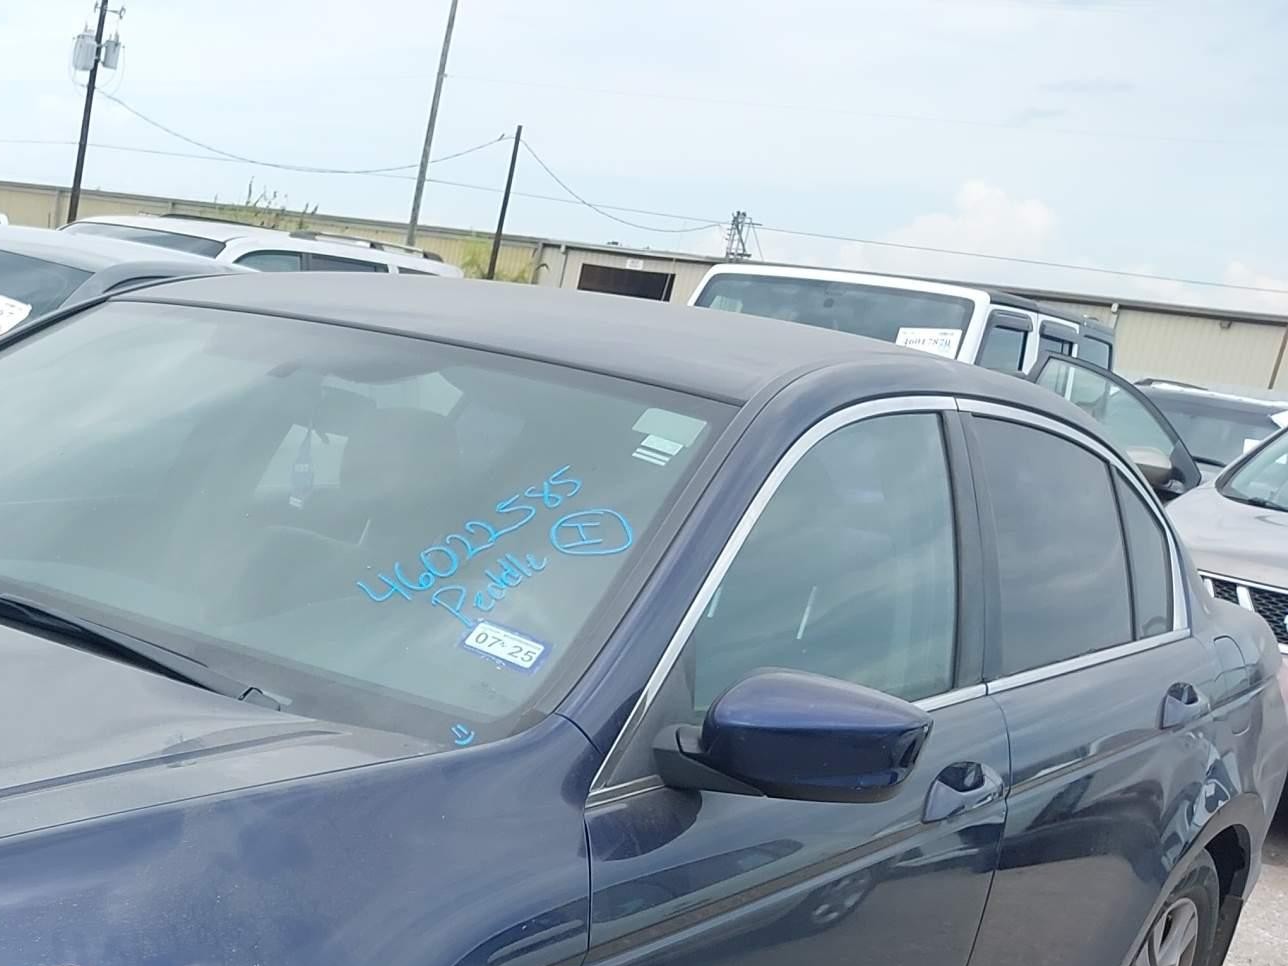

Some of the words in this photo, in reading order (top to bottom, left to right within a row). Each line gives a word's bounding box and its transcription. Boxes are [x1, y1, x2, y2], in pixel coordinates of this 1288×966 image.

[356, 464, 582, 602] 46022585
[474, 632, 503, 648] 07
[507, 645, 537, 663] 25
